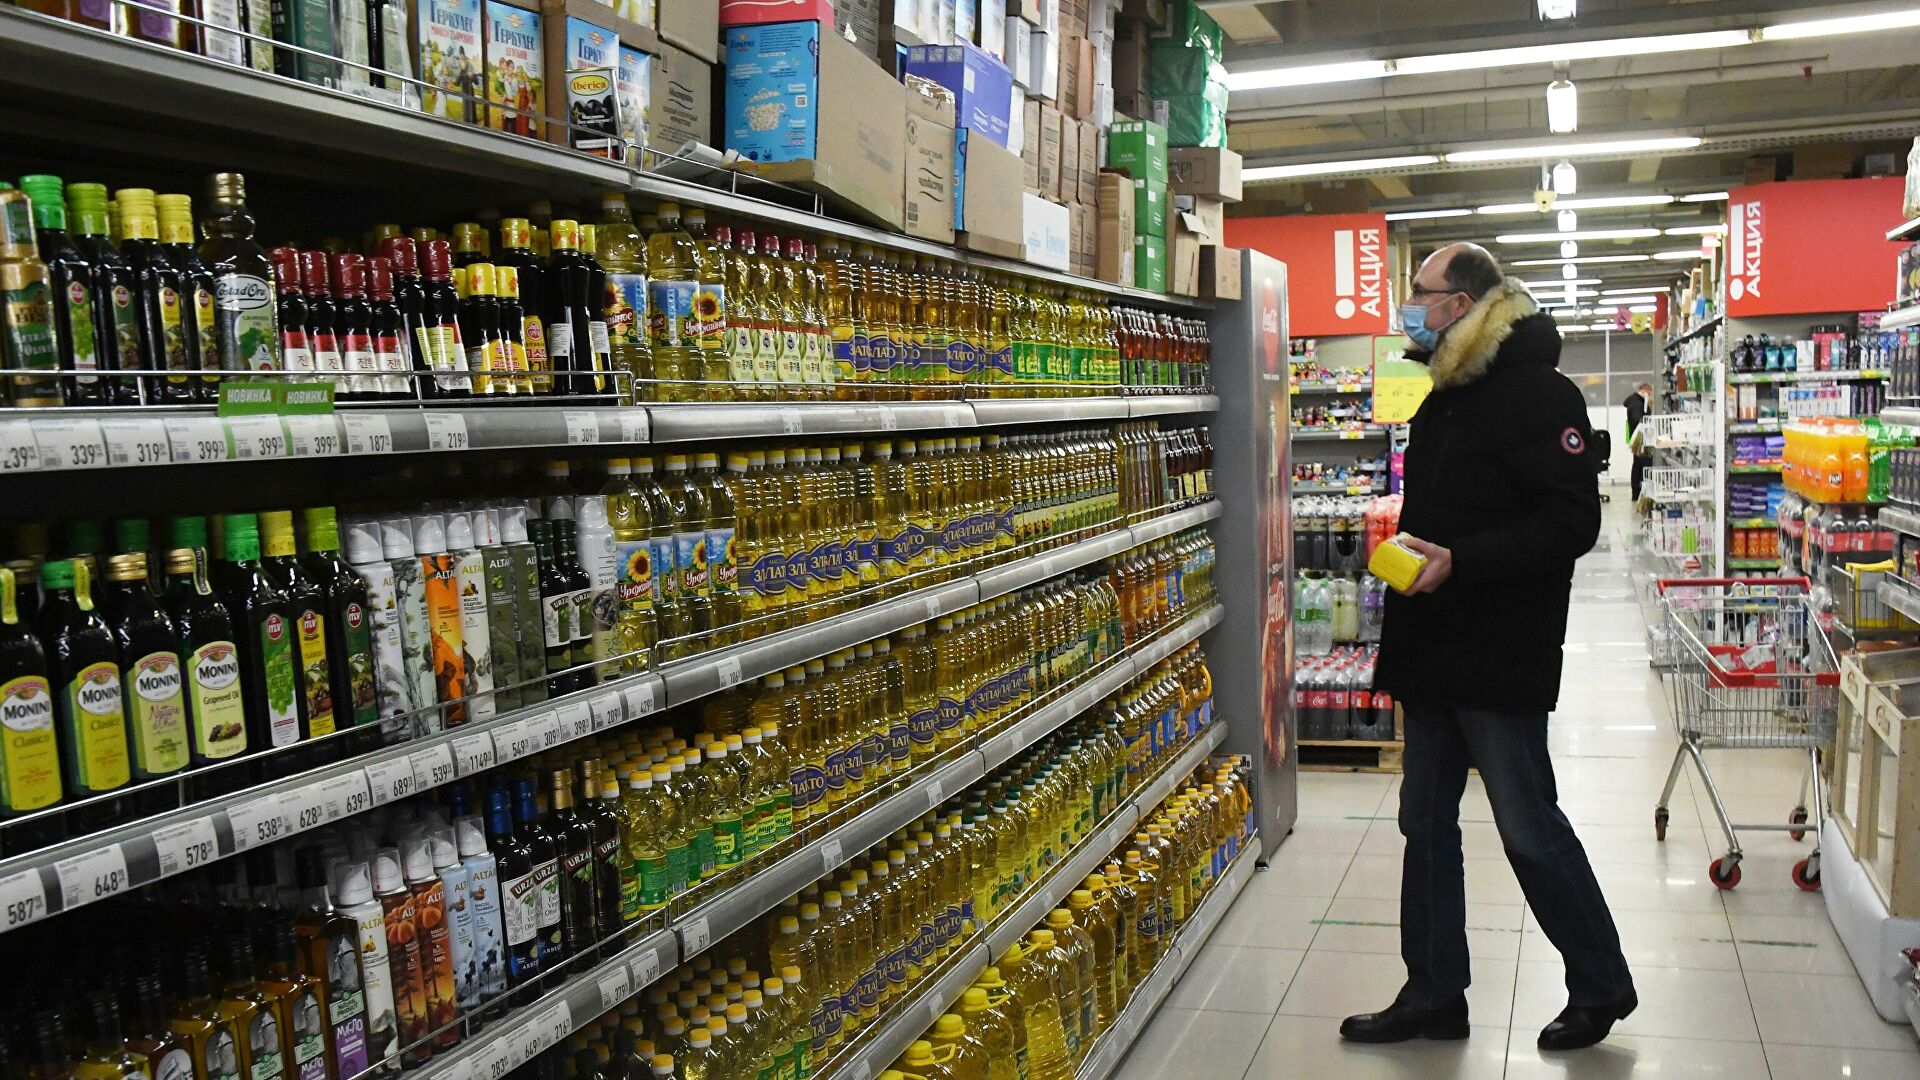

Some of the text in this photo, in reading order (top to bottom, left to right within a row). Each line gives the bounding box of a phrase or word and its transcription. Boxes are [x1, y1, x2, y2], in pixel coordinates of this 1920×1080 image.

[573, 80, 606, 92] Iberica
[1745, 200, 1763, 298] АКЦИЯ
[1360, 228, 1384, 318] АКЦИЯ
[227, 388, 272, 404] НОВИНКА
[286, 389, 329, 404] НОВИНКА
[259, 437, 278, 456] 399
[315, 436, 332, 454] 399
[369, 435, 385, 451] 187
[448, 432, 462, 448] 219
[71, 444, 95, 465] 339
[137, 443, 160, 463] 319
[198, 441, 219, 460] 399
[512, 742, 526, 758] 549
[470, 753, 488, 771] 1149
[432, 766, 448, 783] 539
[393, 777, 409, 796] 689
[346, 792, 363, 813] 639
[300, 807, 318, 828] 628
[258, 818, 278, 841] 538
[186, 842, 208, 866] 578
[95, 871, 119, 897] 648
[8, 897, 35, 925] 587
[554, 1024, 568, 1040] 216
[525, 1039, 538, 1059] 649
[490, 1058, 506, 1078] 283
